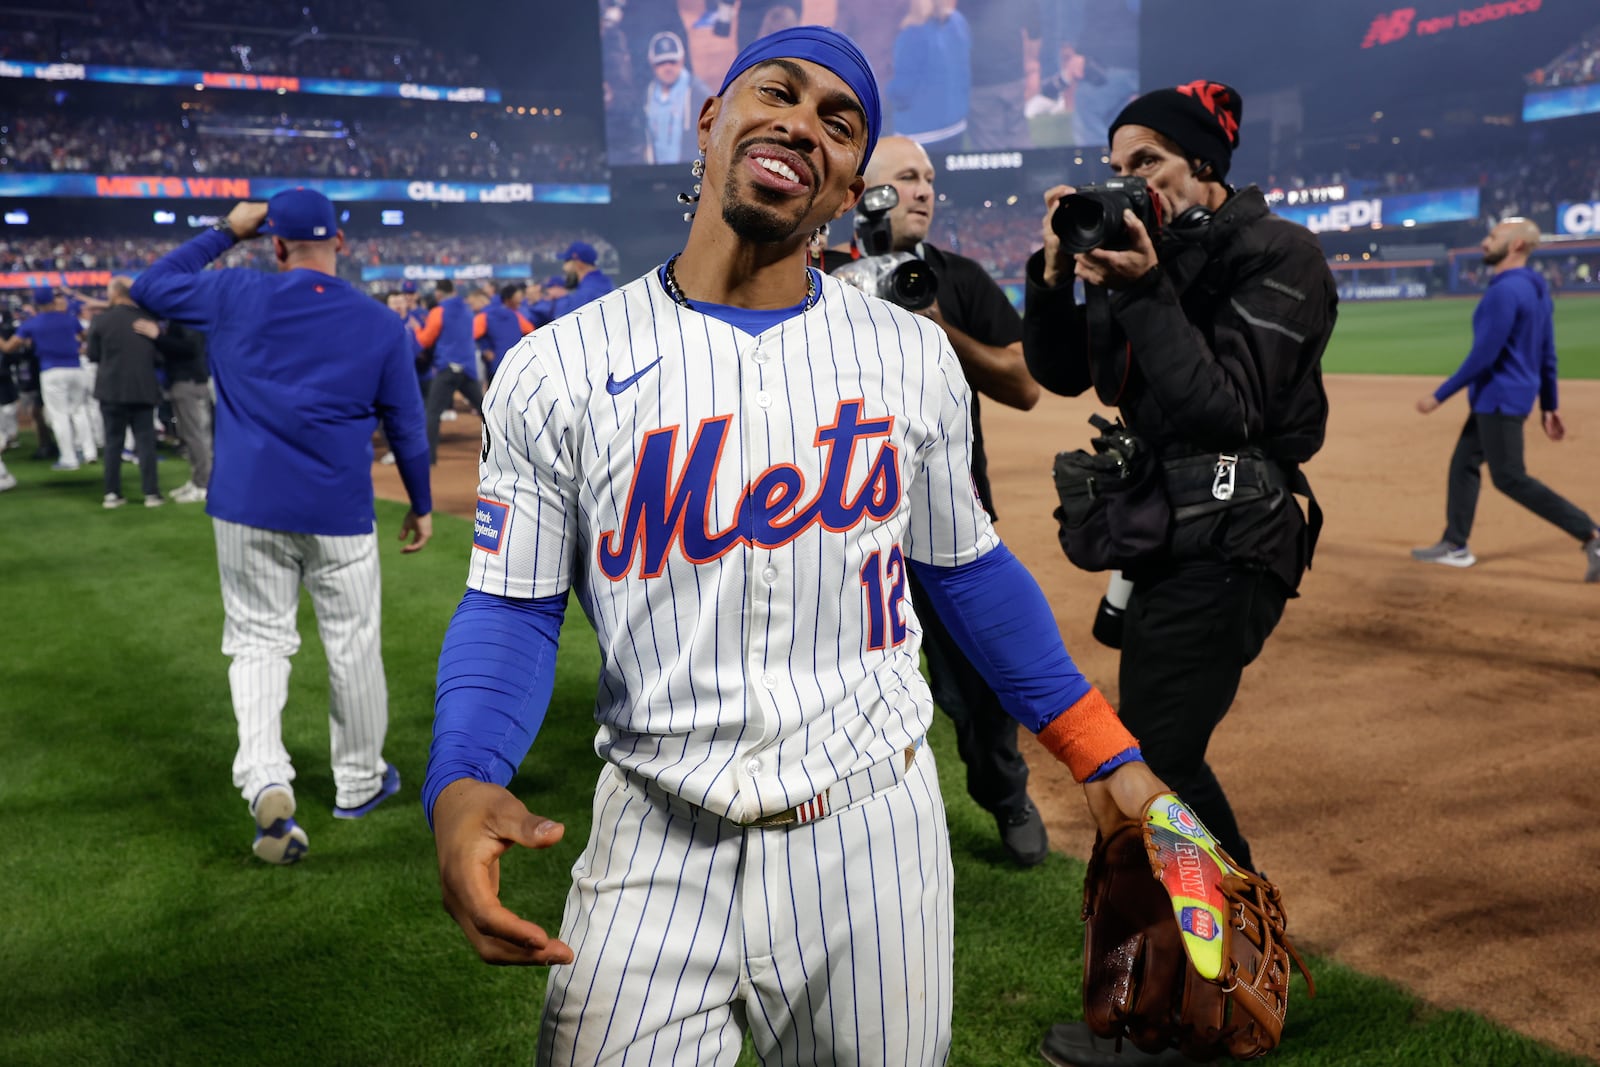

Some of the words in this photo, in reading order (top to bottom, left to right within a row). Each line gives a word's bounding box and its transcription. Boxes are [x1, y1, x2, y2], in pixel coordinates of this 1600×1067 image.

[1416, 15, 1455, 36] new
[1458, 0, 1542, 27] balance
[203, 72, 257, 90] METS
[946, 152, 1023, 171] SAMSUNG
[96, 176, 185, 197] METS
[186, 177, 249, 198] WIN!
[597, 397, 899, 582] Mets
[860, 543, 906, 652] 12
[1174, 842, 1206, 897] FDNY
[1196, 910, 1209, 937] 343
